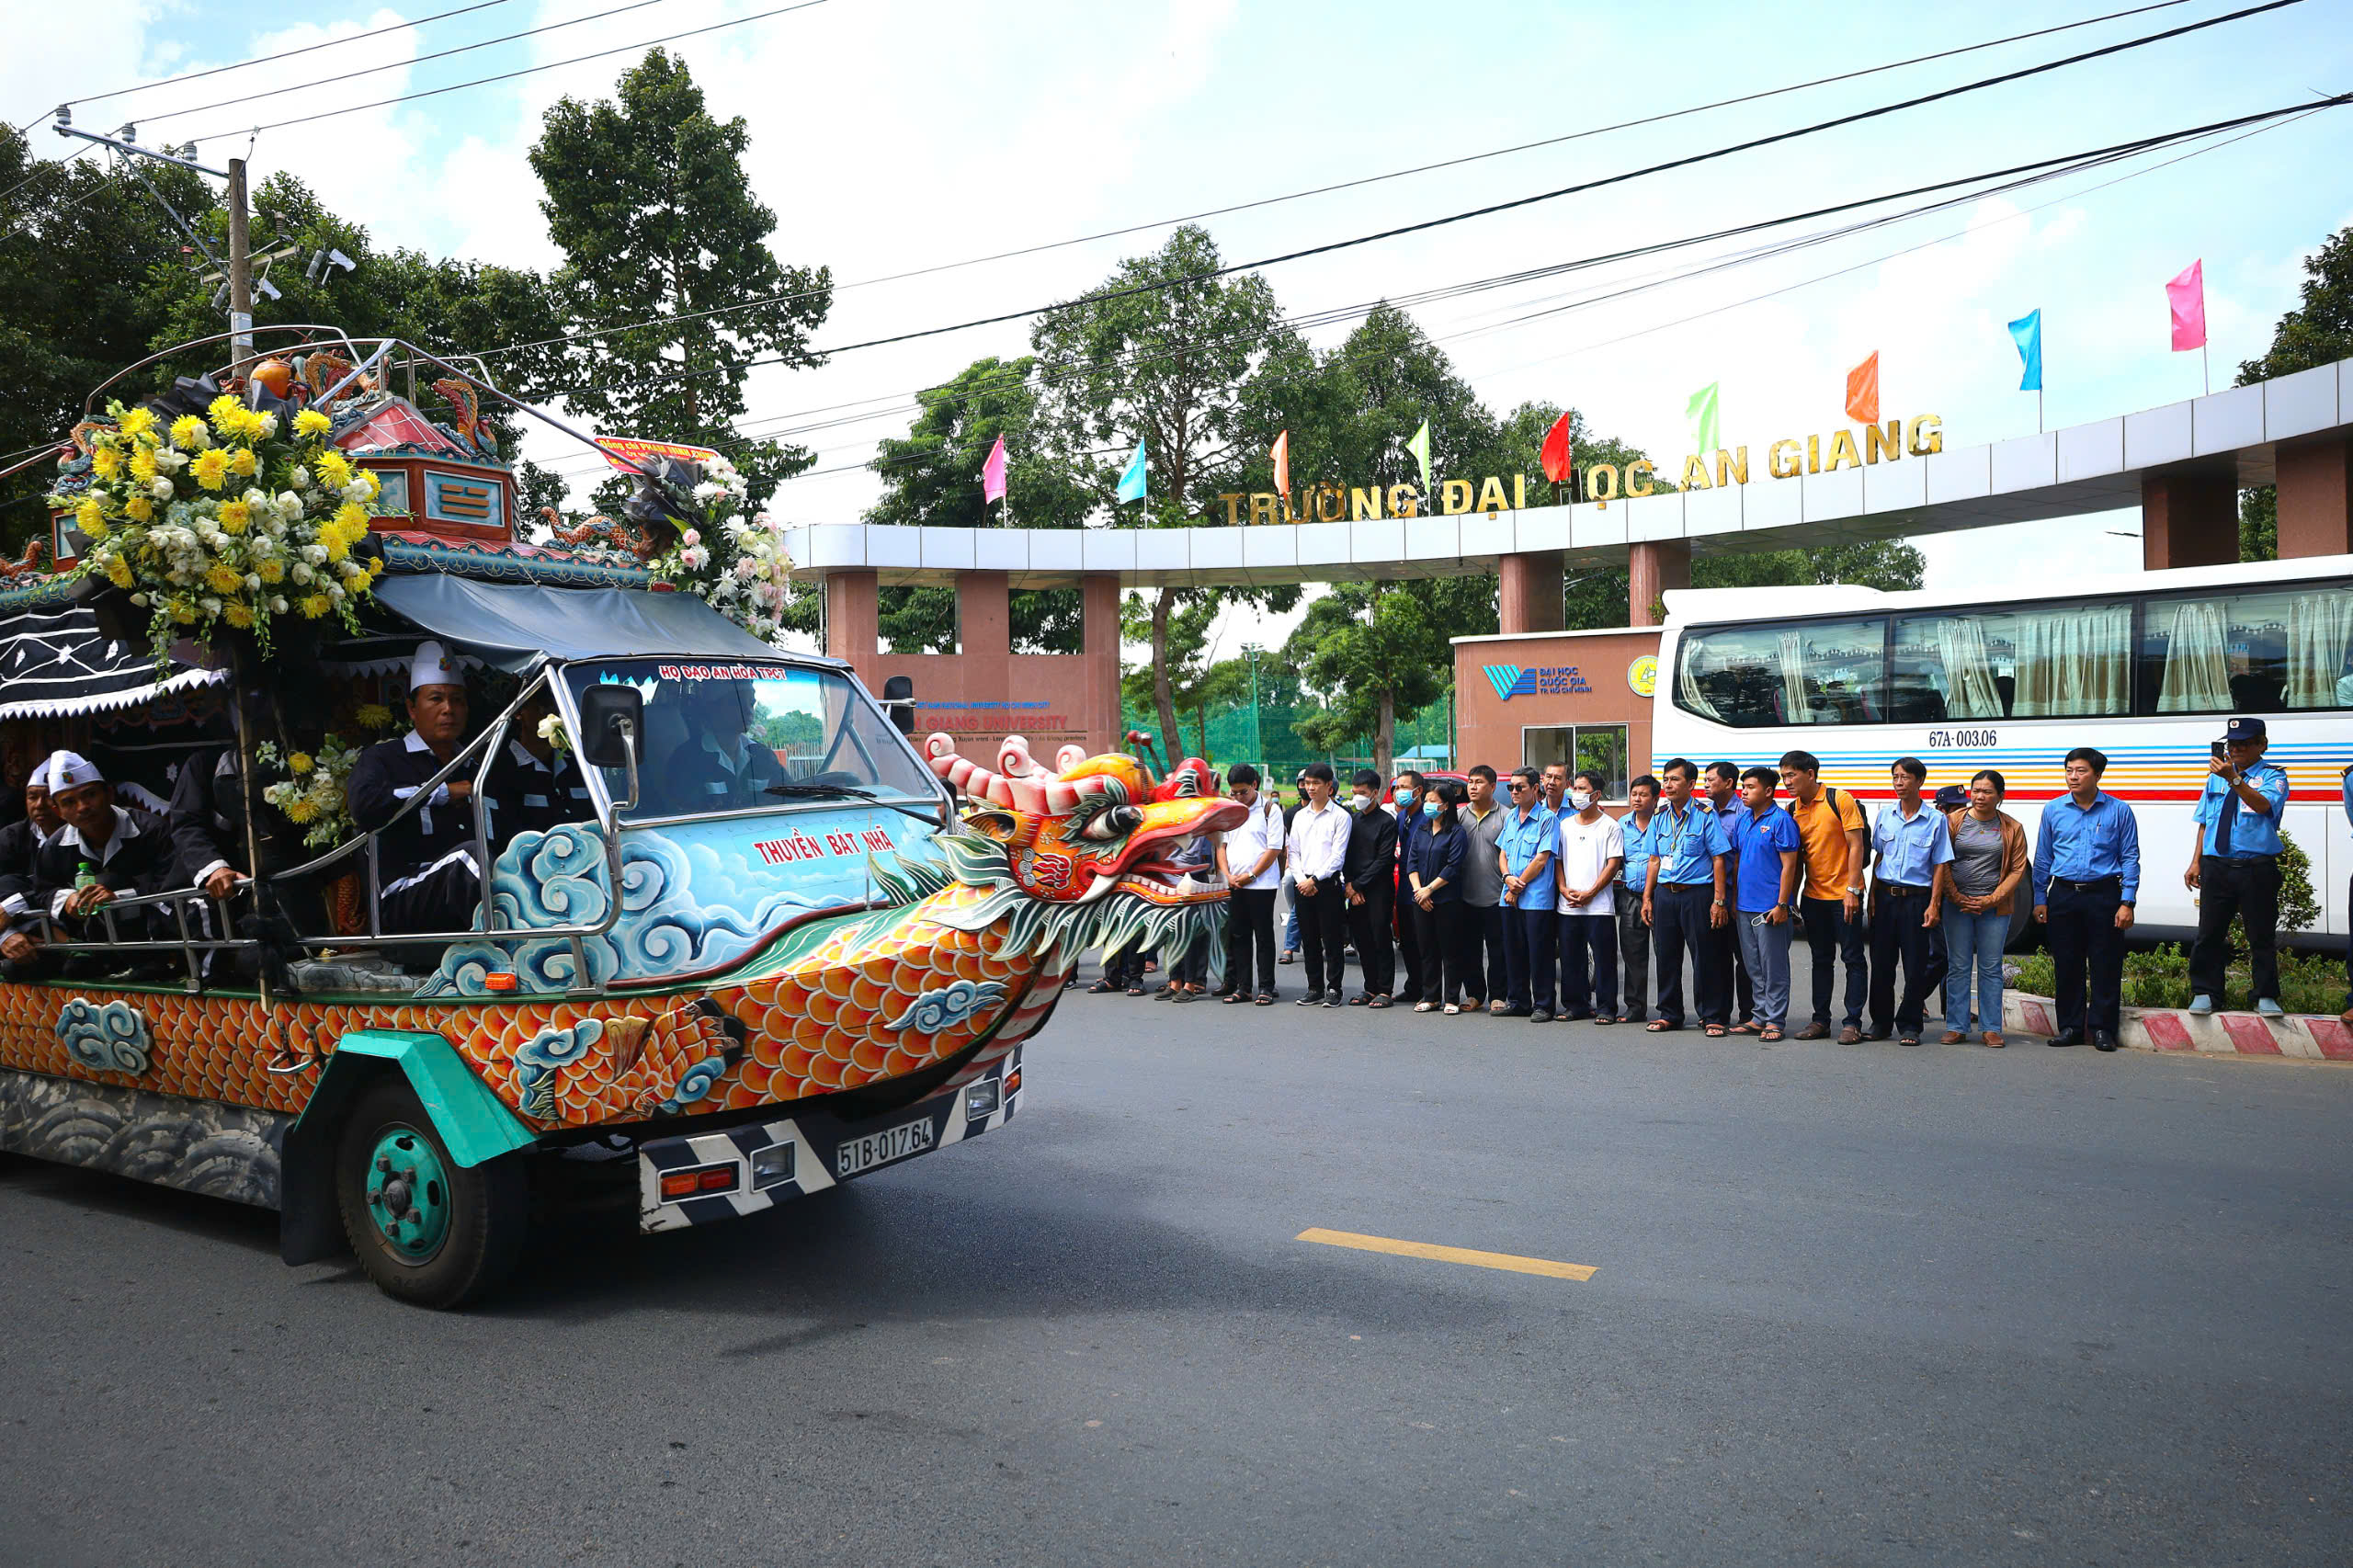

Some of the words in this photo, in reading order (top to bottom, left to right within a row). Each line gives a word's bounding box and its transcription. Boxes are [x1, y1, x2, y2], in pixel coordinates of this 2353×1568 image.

[1218, 481, 1417, 527] TRƯỜNG
[1441, 473, 1525, 520] ĐẠI
[1551, 460, 1654, 510] HỌC
[1678, 446, 1748, 493] AN
[1768, 413, 1943, 479] GIANG
[659, 665, 680, 682] HỌ
[681, 665, 710, 682] ĐẠO
[711, 666, 731, 679] AN
[732, 664, 757, 679] HÒA
[757, 668, 787, 680] TPCT
[1540, 668, 1555, 677] ĐẠI
[1558, 667, 1578, 677] HỌC
[1570, 677, 1586, 686] GIA
[926, 715, 979, 731] GIANG
[983, 715, 1068, 731] UNIVERSITY
[1929, 730, 1997, 747] 67A-003.06
[754, 828, 824, 865] THUYỀN
[826, 828, 860, 856] BÁT
[861, 825, 895, 852] NHÃ
[839, 1120, 931, 1173] 51B-017.64
